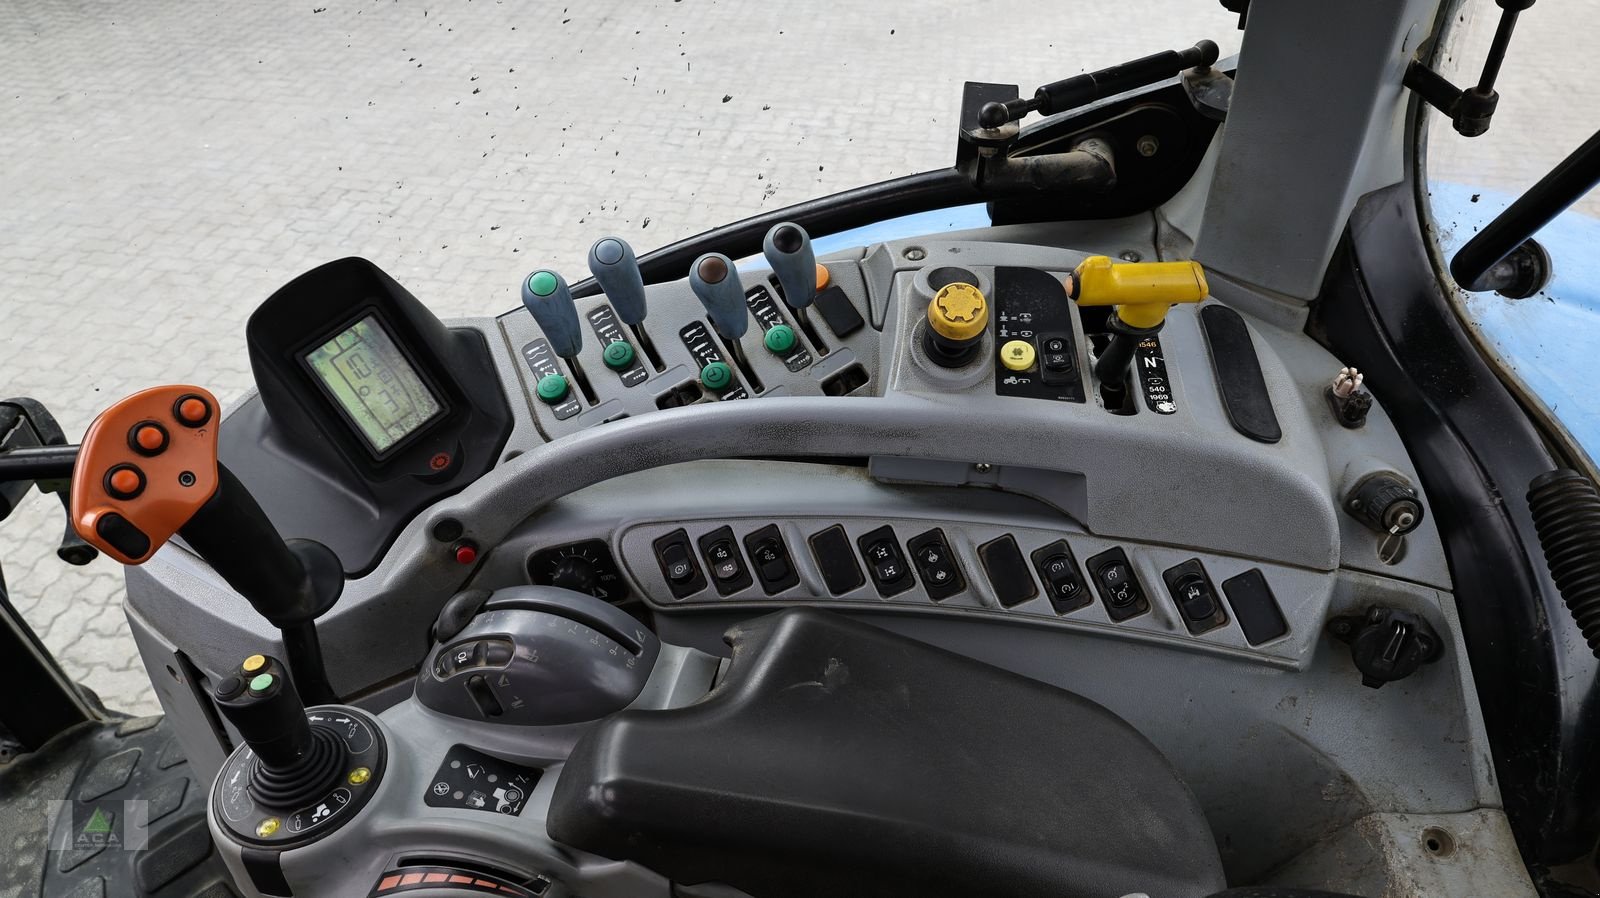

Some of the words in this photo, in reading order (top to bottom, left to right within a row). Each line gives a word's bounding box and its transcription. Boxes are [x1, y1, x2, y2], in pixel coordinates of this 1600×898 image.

[1144, 356, 1157, 368] N
[458, 651, 467, 664] 10
[626, 658, 635, 669] 10
